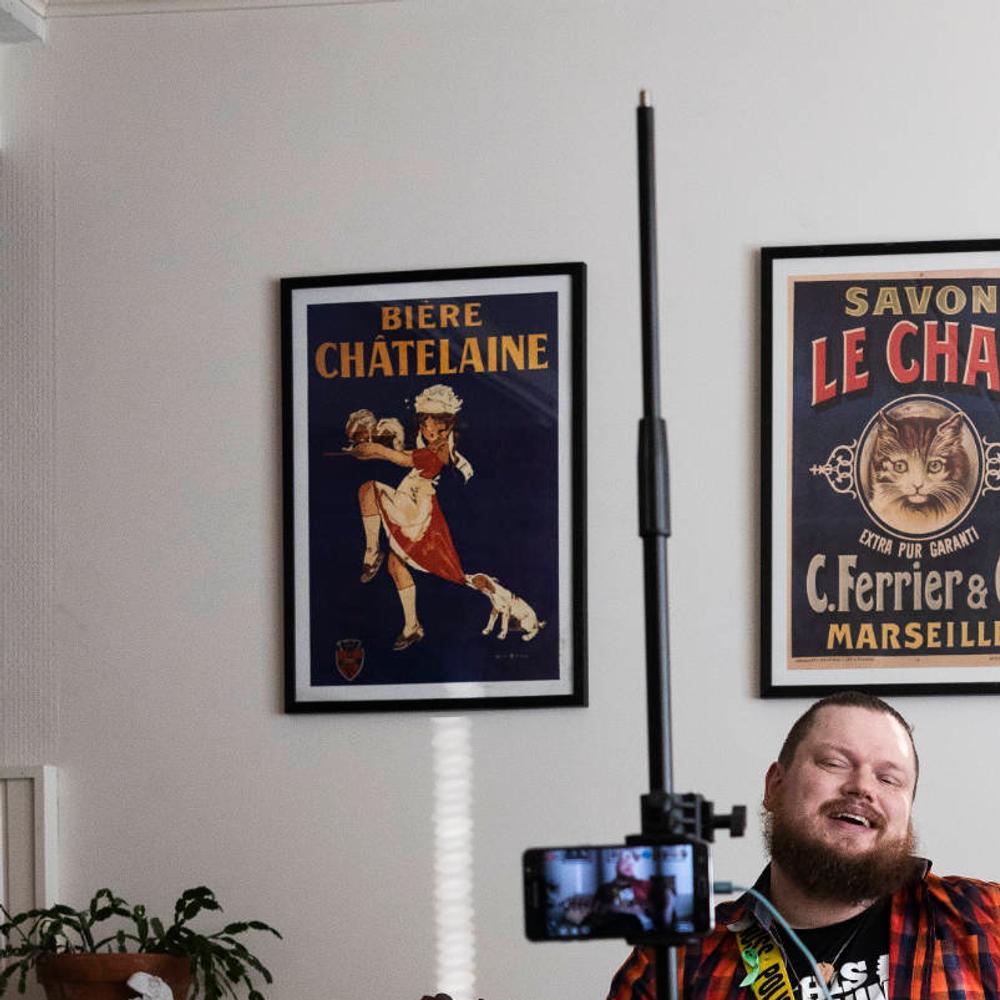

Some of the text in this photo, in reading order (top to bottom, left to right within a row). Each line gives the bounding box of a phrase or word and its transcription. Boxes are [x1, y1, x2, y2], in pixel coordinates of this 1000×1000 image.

[844, 284, 998, 317] SAVON
[314, 333, 549, 379] CHÂTELAINE
[811, 326, 870, 406] LE
[859, 526, 981, 559] EXTRA PUR GARANTI
[967, 573, 988, 610] &
